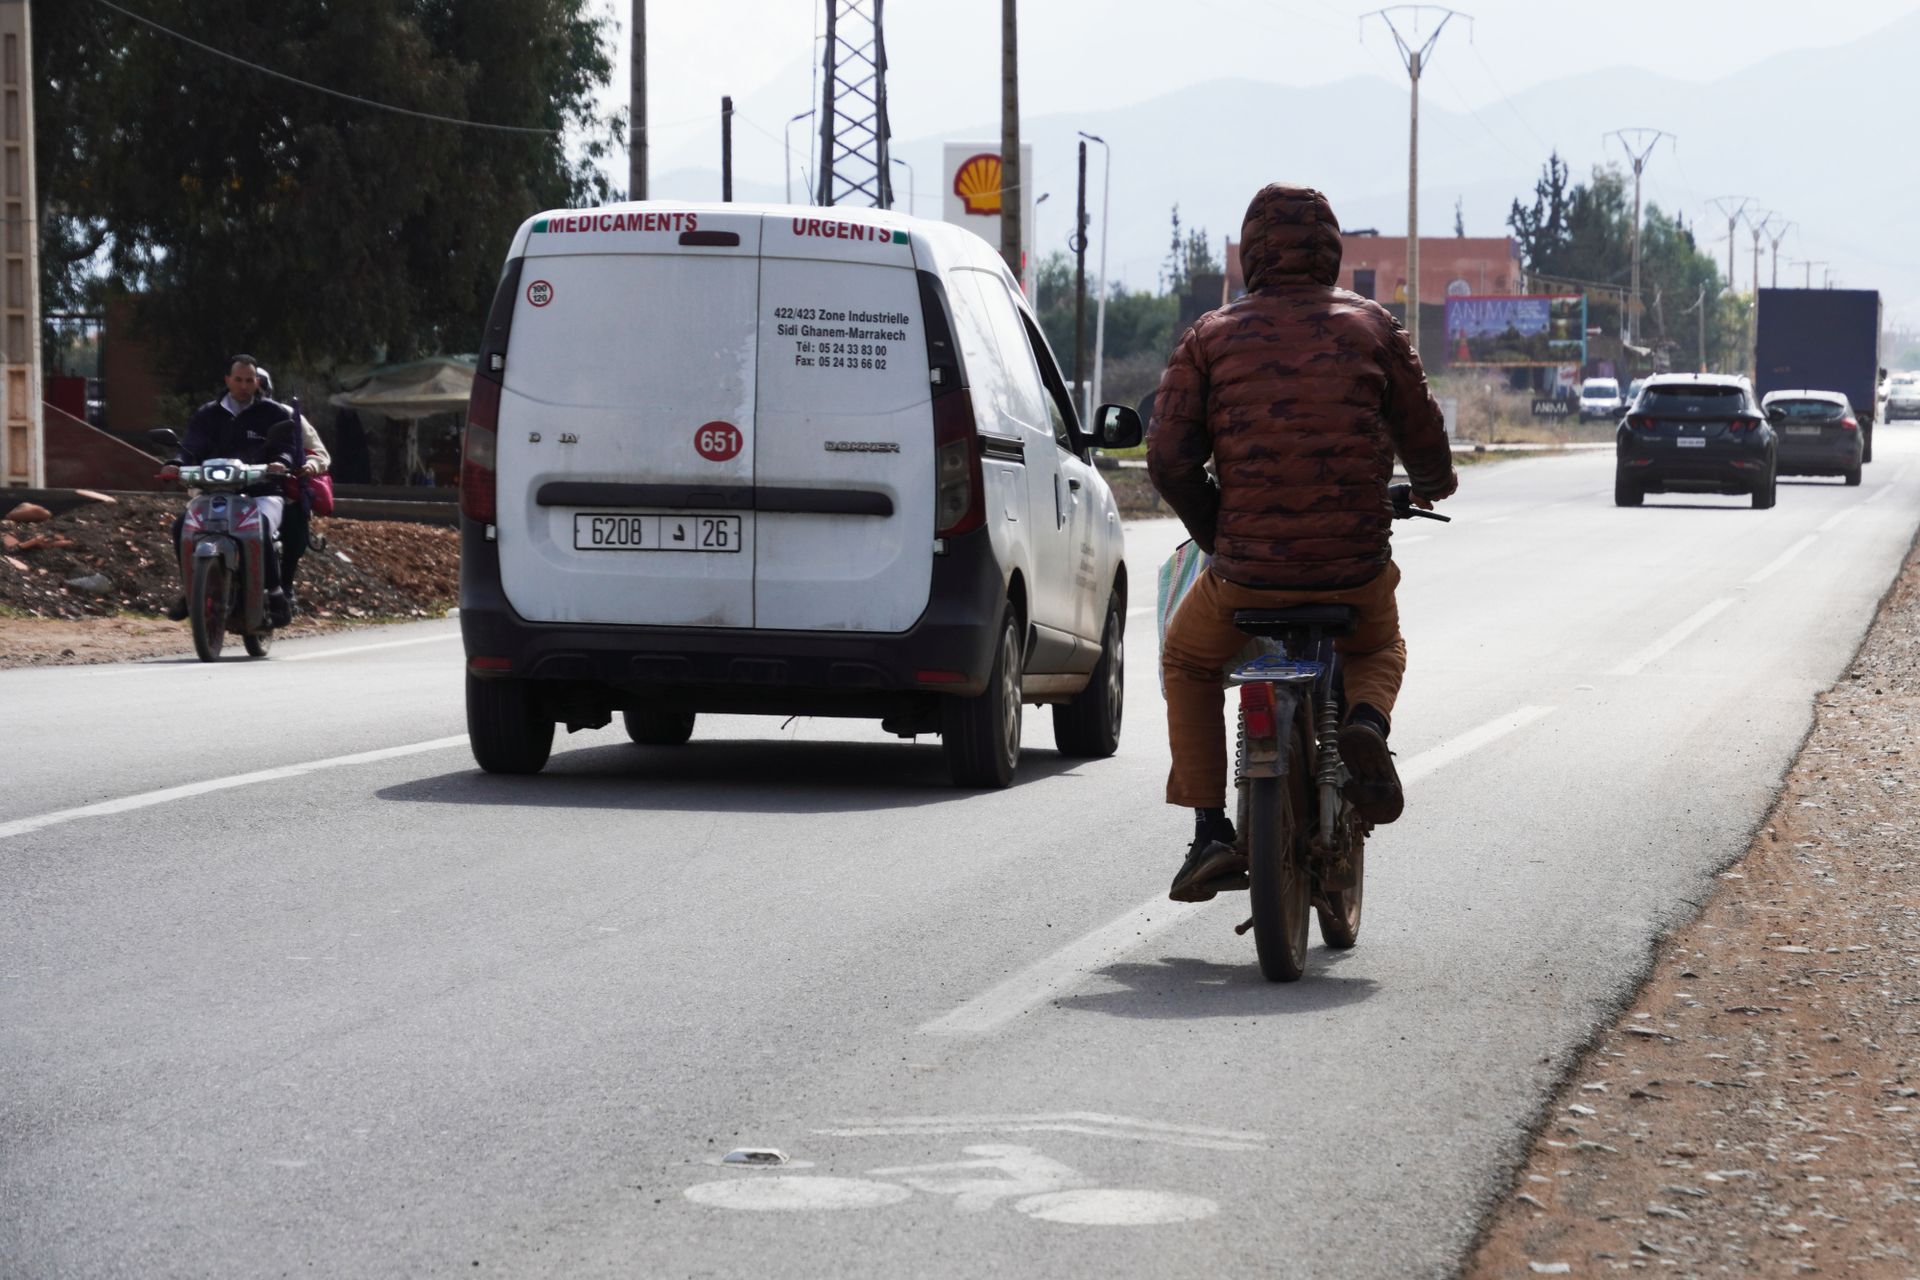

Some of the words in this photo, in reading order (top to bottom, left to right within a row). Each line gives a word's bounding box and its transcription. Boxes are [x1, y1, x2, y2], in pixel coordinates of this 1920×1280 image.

[549, 213, 698, 233] MEDICAMENTS
[792, 217, 891, 243] URGENTS
[774, 308, 816, 320] 422/423
[818, 309, 846, 321] Zone
[849, 310, 909, 325] Industrielle
[1450, 301, 1516, 320] ANIMA
[777, 324, 798, 336] Sidi
[818, 343, 830, 353] 05
[833, 343, 844, 354] 24
[847, 344, 859, 355] 33
[861, 345, 873, 356] 83
[875, 345, 887, 356] 00
[795, 355, 815, 366] Fax:
[818, 356, 830, 367] 05
[833, 357, 844, 368] 24
[847, 357, 859, 368] 33
[861, 358, 873, 369] 66
[875, 359, 887, 370] 02
[701, 430, 737, 452] 651
[592, 518, 641, 545] 6208
[703, 520, 727, 547] 26
